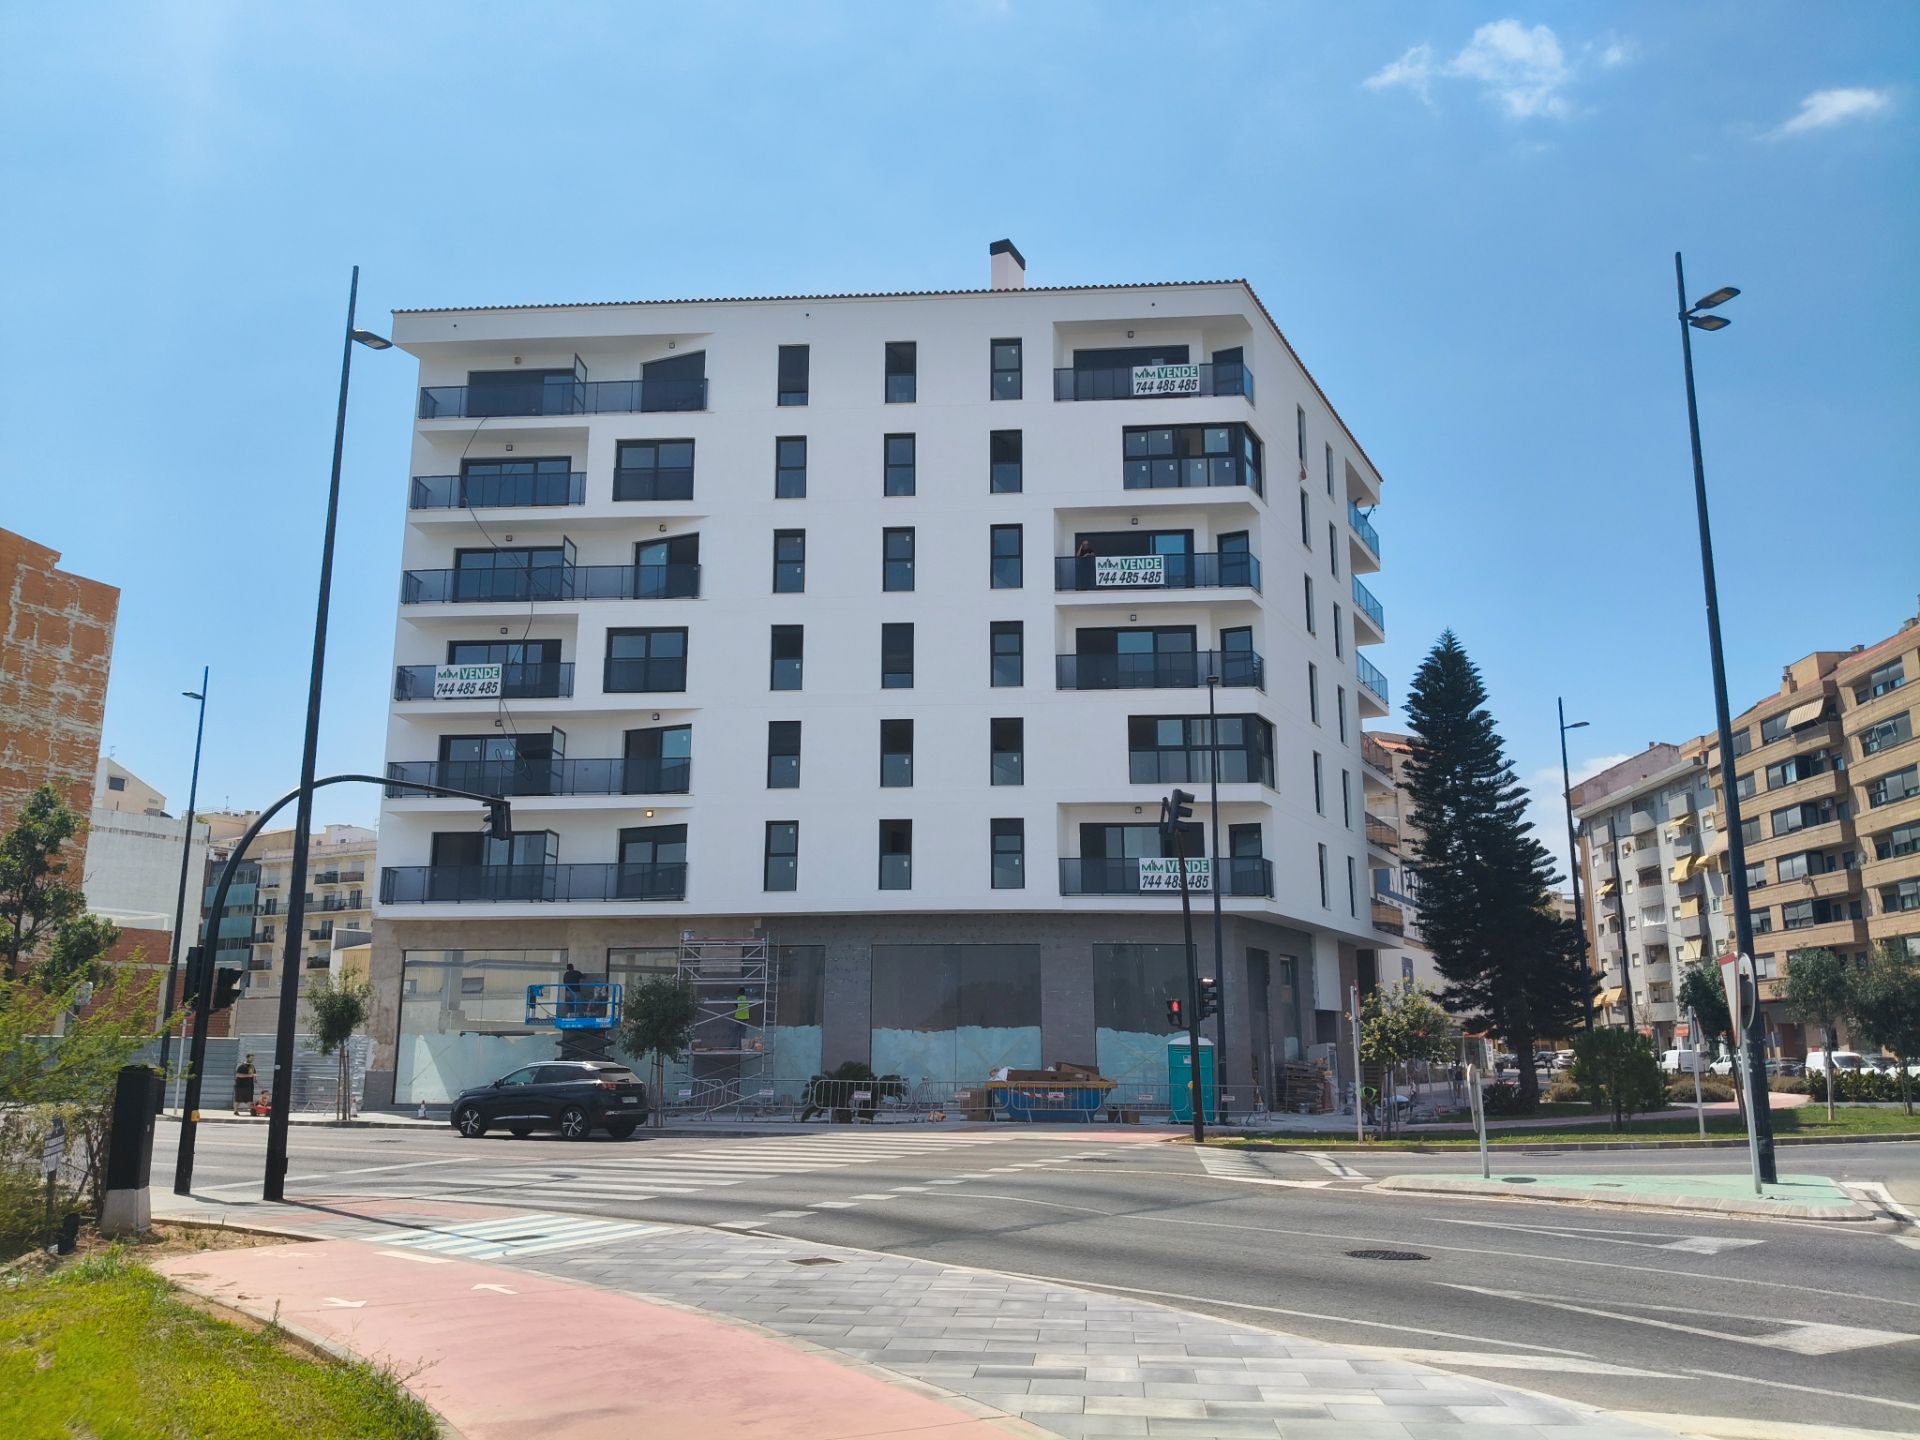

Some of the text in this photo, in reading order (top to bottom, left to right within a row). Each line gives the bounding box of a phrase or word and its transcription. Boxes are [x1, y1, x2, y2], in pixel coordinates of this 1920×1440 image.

[1158, 366, 1197, 378] VENDE
[1136, 379, 1198, 394] 744 485 485
[1121, 558, 1161, 570] VENDE
[1098, 571, 1162, 584] 744 485 485
[461, 667, 499, 679] VENDE
[436, 681, 499, 695] 744 485 485
[1142, 875, 1162, 888] 744
[1188, 875, 1209, 888] 485
